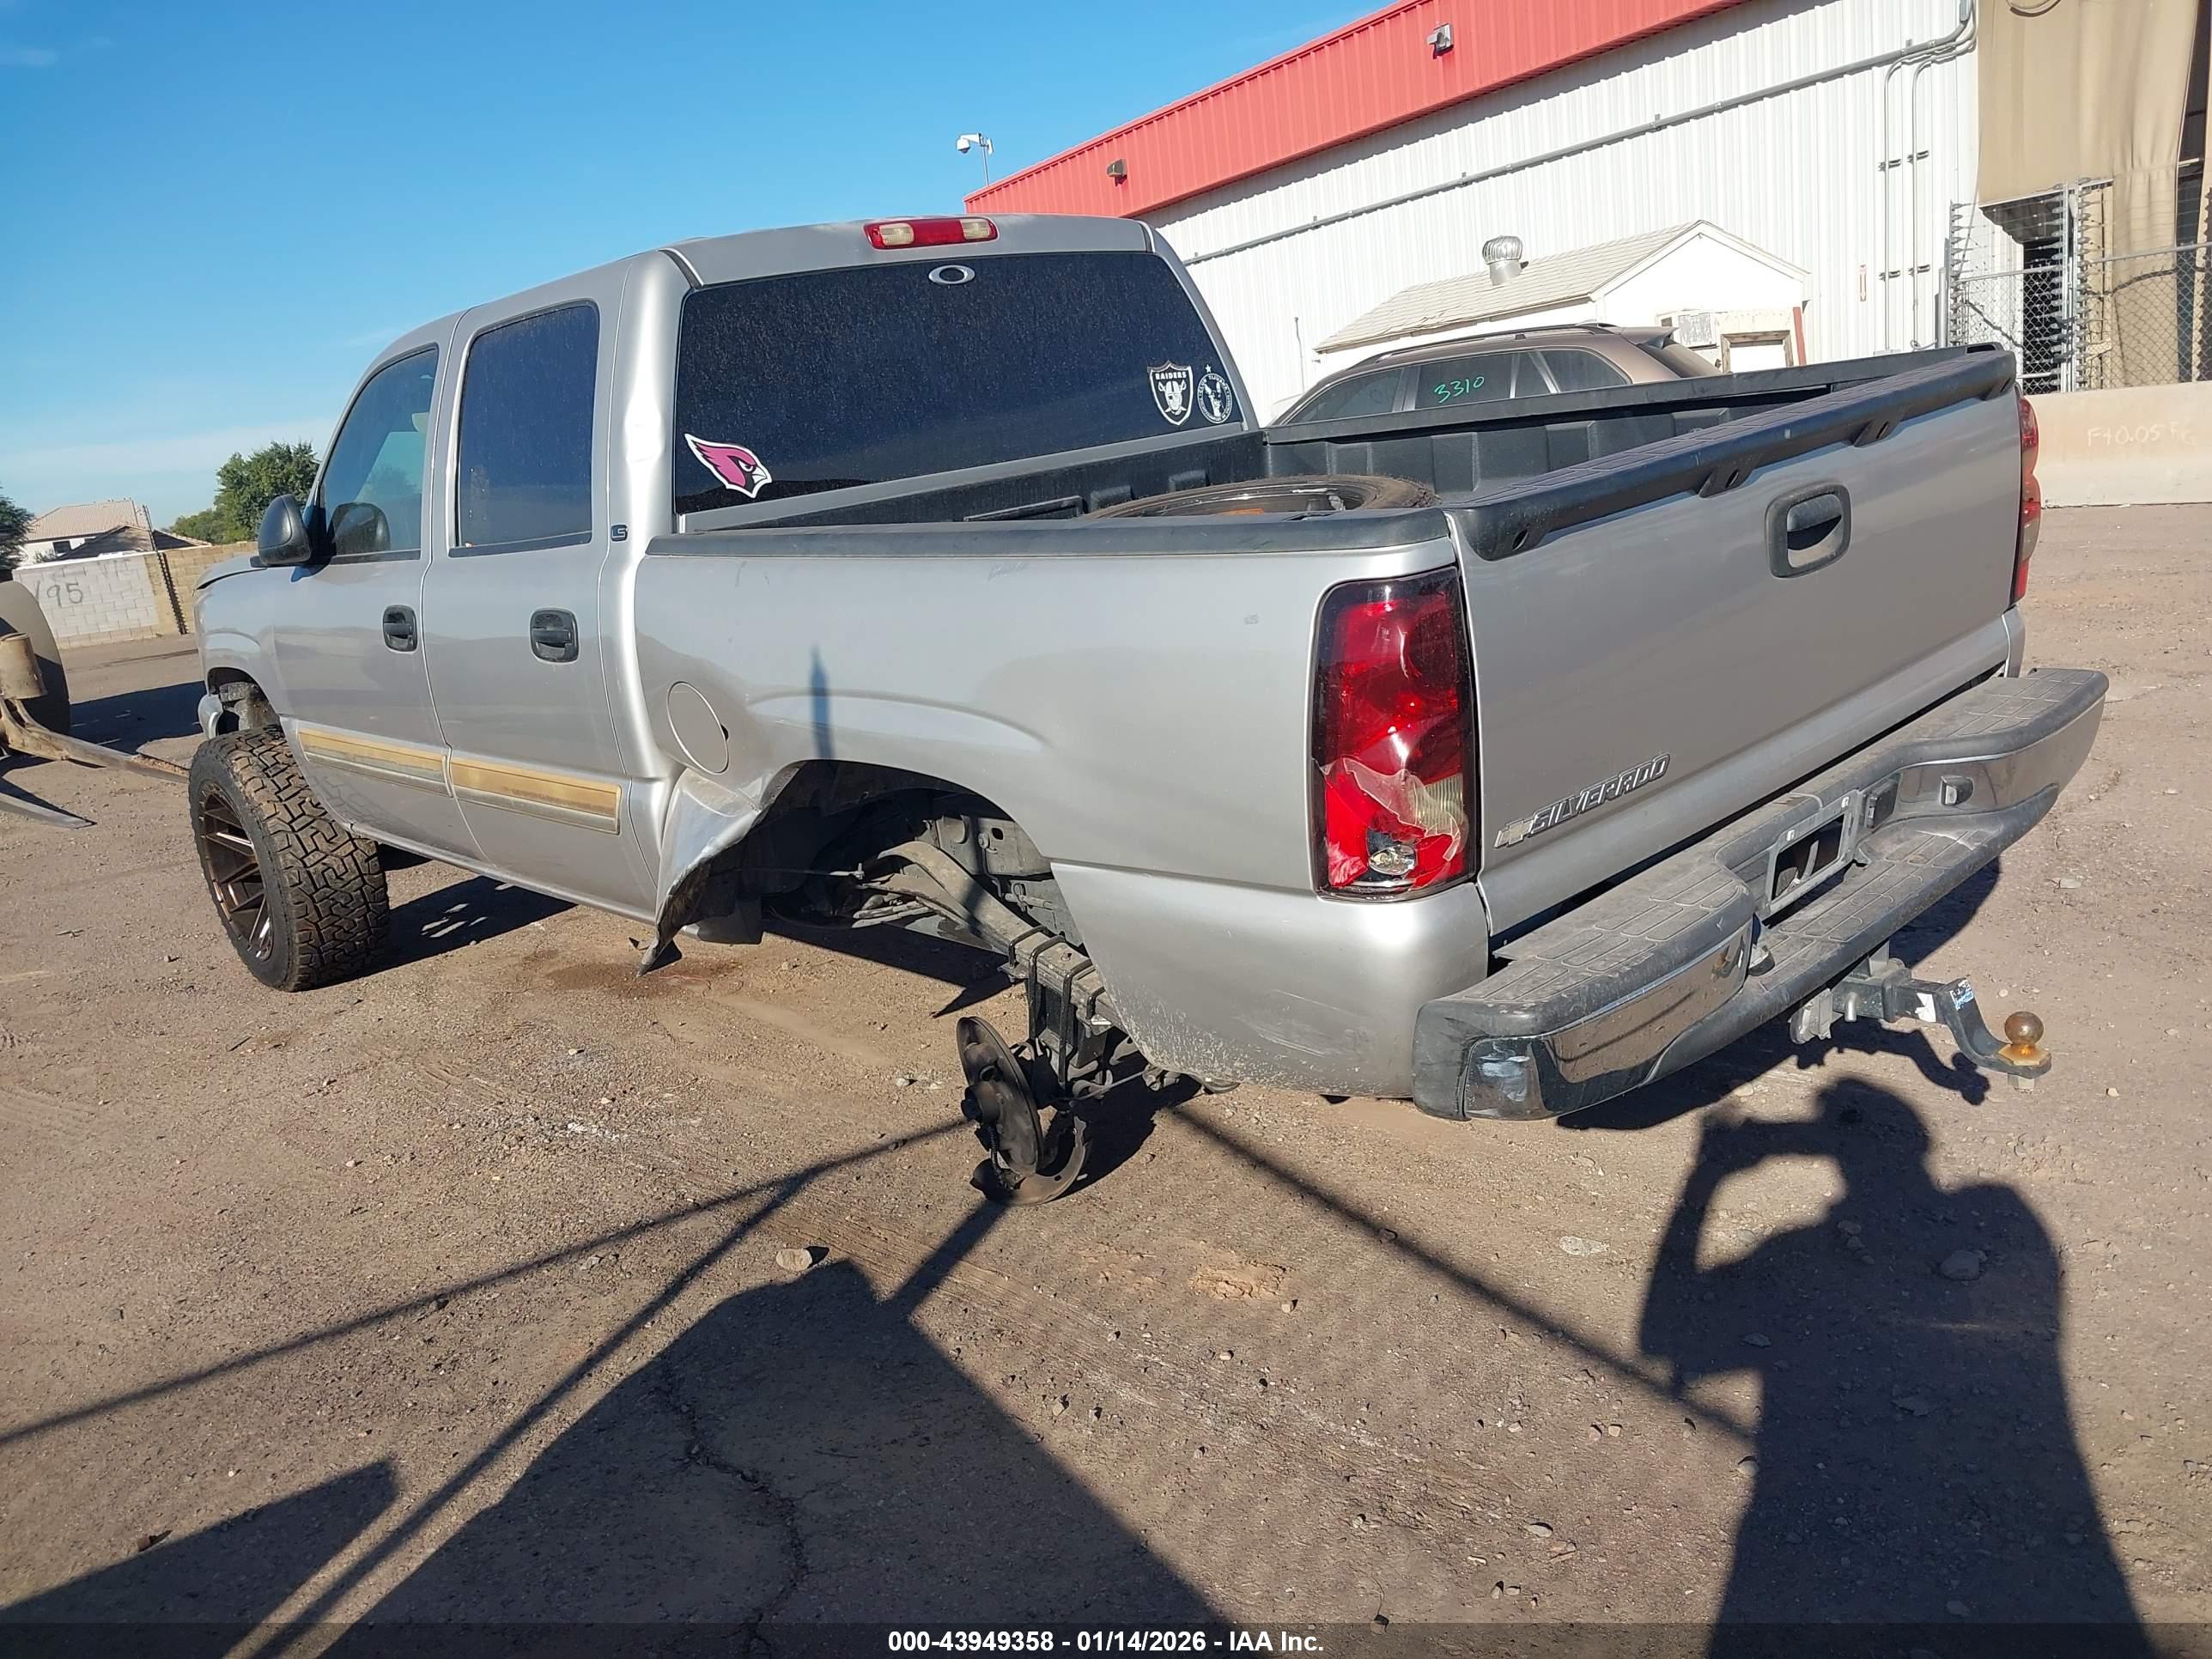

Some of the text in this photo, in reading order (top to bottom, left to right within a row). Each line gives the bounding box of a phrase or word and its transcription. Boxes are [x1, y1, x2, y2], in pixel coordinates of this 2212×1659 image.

[1155, 371, 1187, 380] RAIDERS
[1433, 376, 1485, 404] 3310
[1530, 753, 1671, 835] SILVERADO
